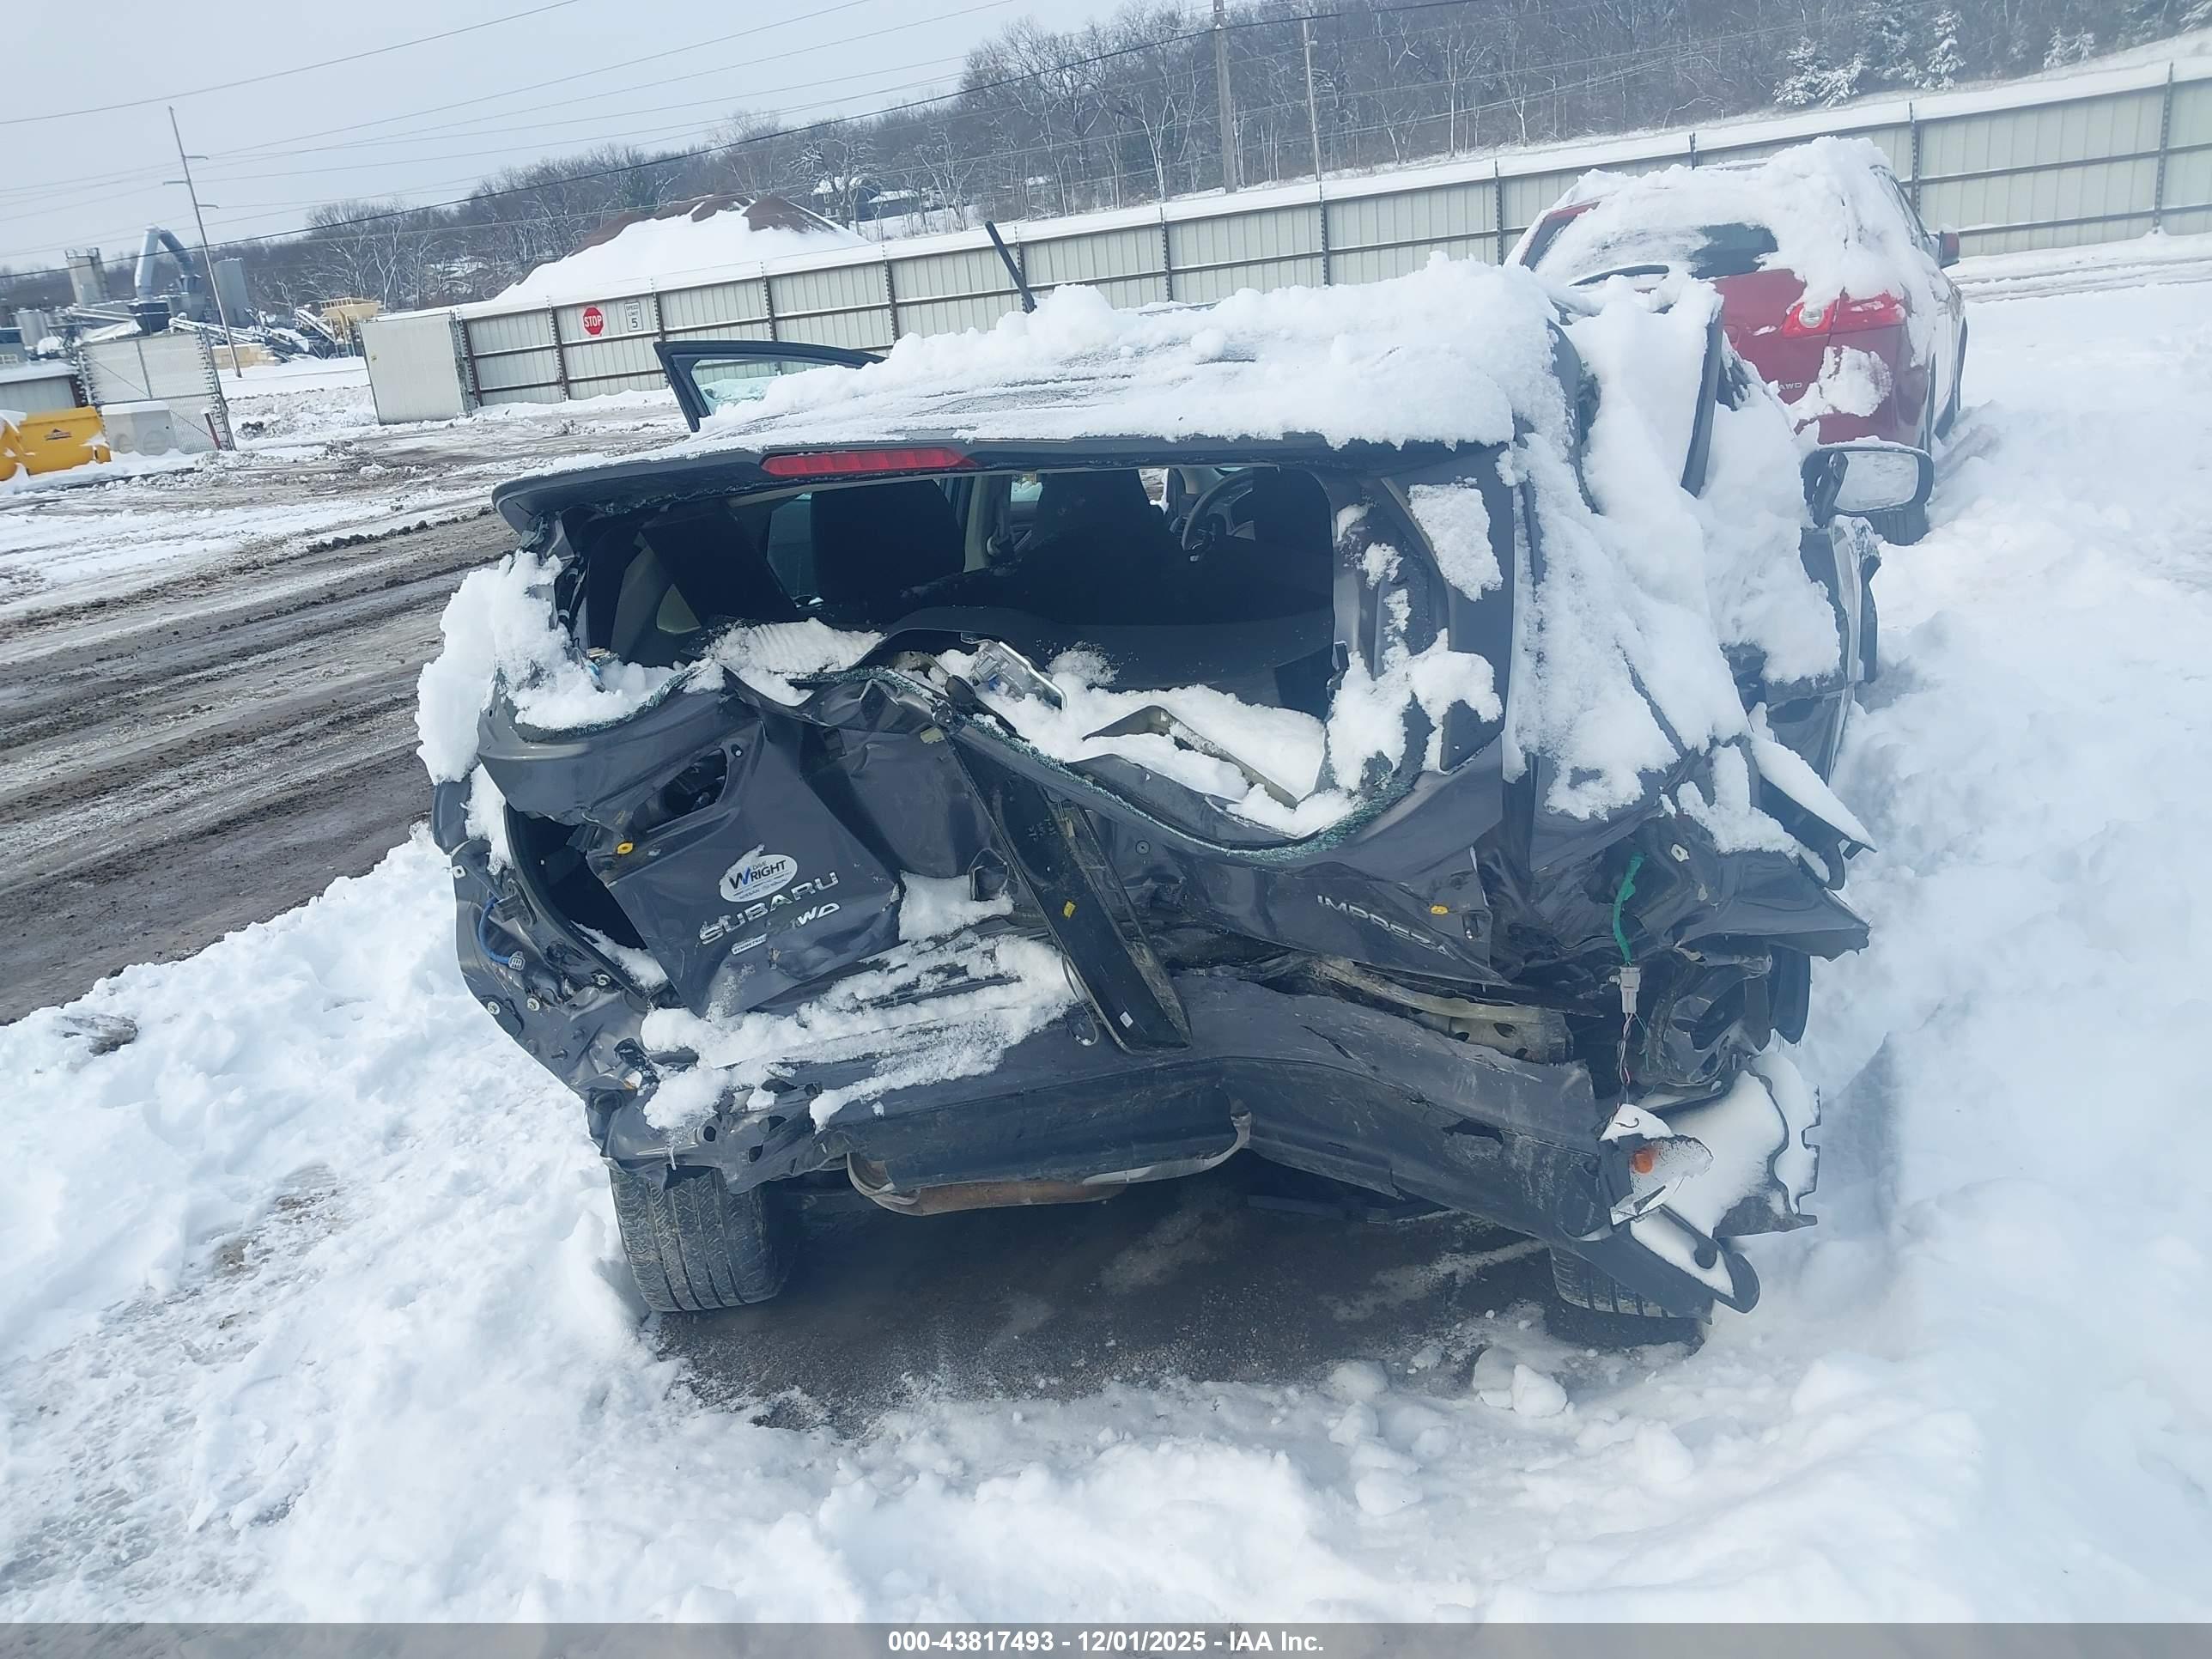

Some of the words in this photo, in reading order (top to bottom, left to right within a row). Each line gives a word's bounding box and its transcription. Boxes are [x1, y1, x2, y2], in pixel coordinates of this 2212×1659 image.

[583, 315, 603, 328] STOP
[631, 317, 638, 329] 5
[728, 860, 787, 890] WRIGHT
[752, 860, 767, 871] DAVE
[698, 871, 840, 945] SUBARU
[1316, 894, 1459, 961] IMPREZA
